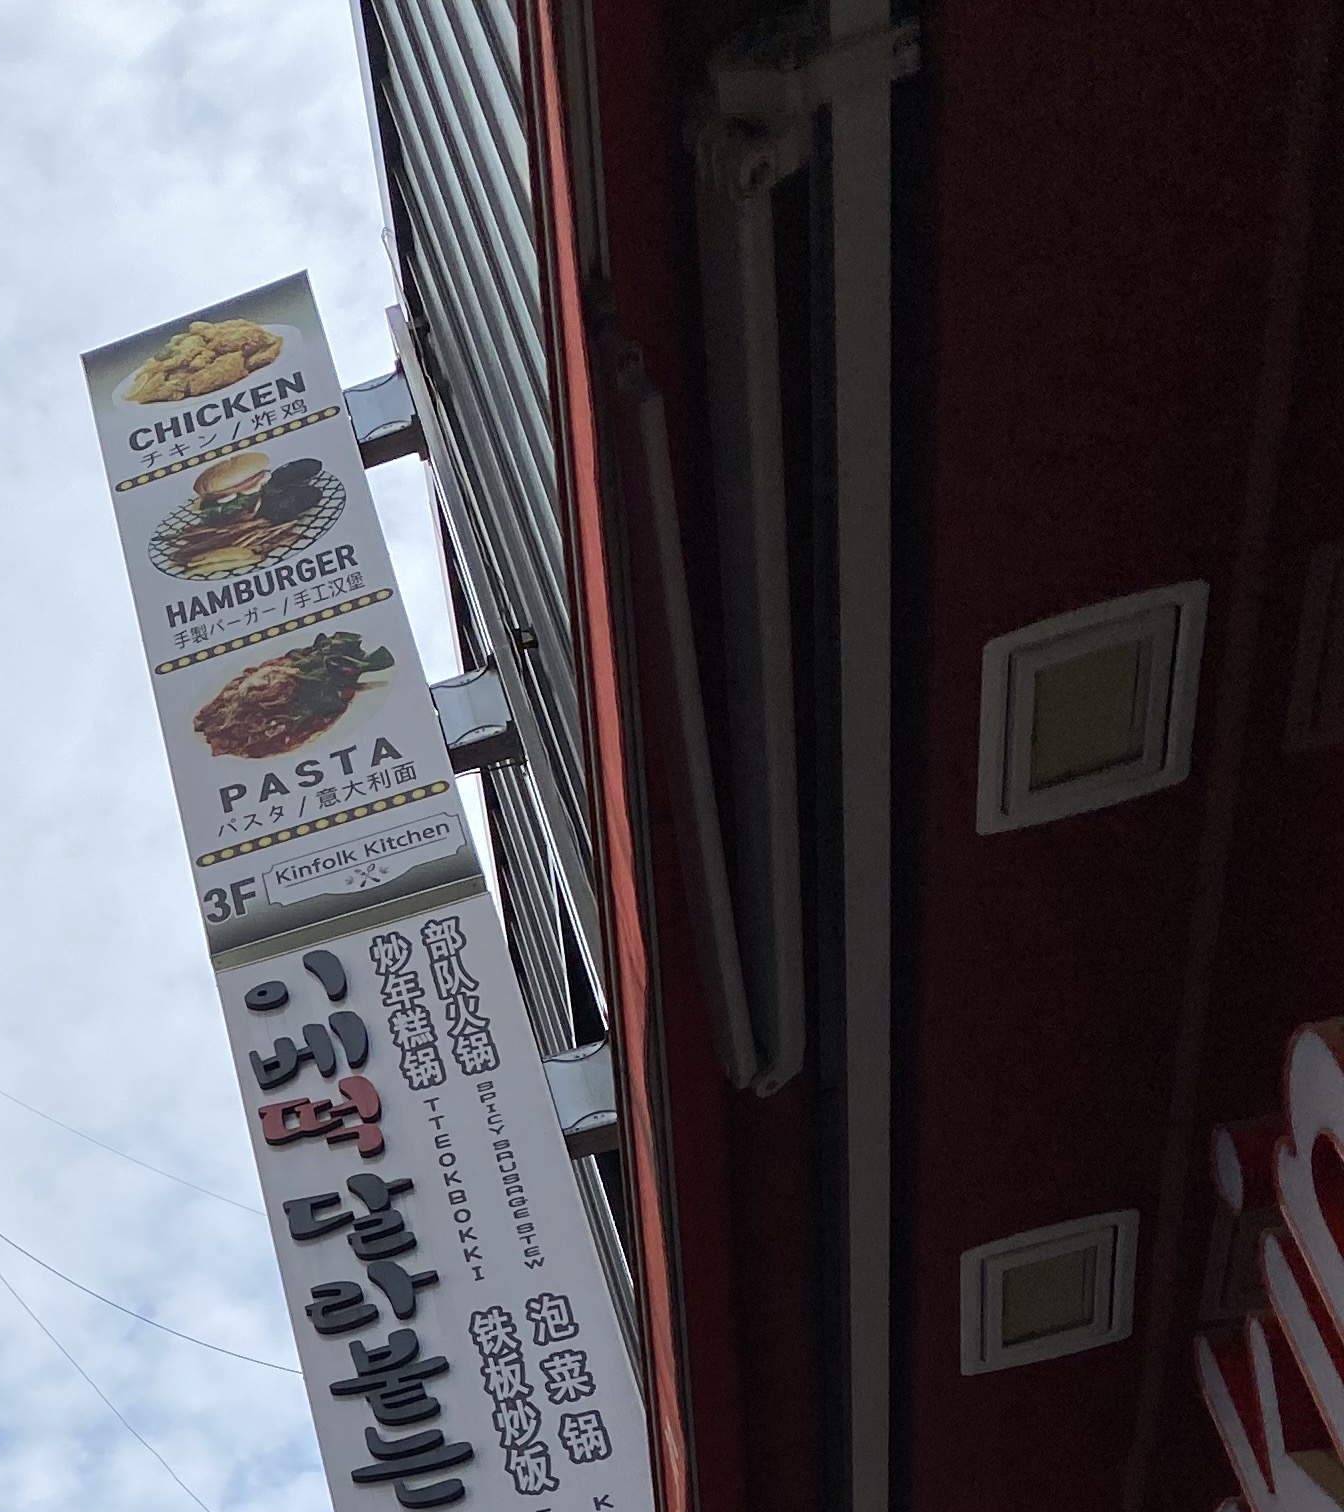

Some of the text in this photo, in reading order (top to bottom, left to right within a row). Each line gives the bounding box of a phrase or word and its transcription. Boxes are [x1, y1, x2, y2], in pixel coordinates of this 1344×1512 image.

[129, 371, 306, 451] CHICKEN
[140, 433, 217, 468] チキン
[165, 543, 360, 628] HAMBURGER
[216, 804, 285, 837] パスタ
[315, 760, 418, 810] 意大利面
[218, 735, 404, 814] PASTA
[274, 821, 451, 886] Kinfolk Kitchen
[202, 876, 257, 925] 3F
[368, 930, 448, 1092] 炒年糕锅
[419, 915, 502, 1077] 部队火锅
[423, 1096, 486, 1282] TTEOKBOKKI
[476, 1079, 546, 1270] SPICY SAUSAGE STEW
[468, 1305, 561, 1496] 铁板炒饭
[524, 1291, 613, 1465] 泡菜锅
